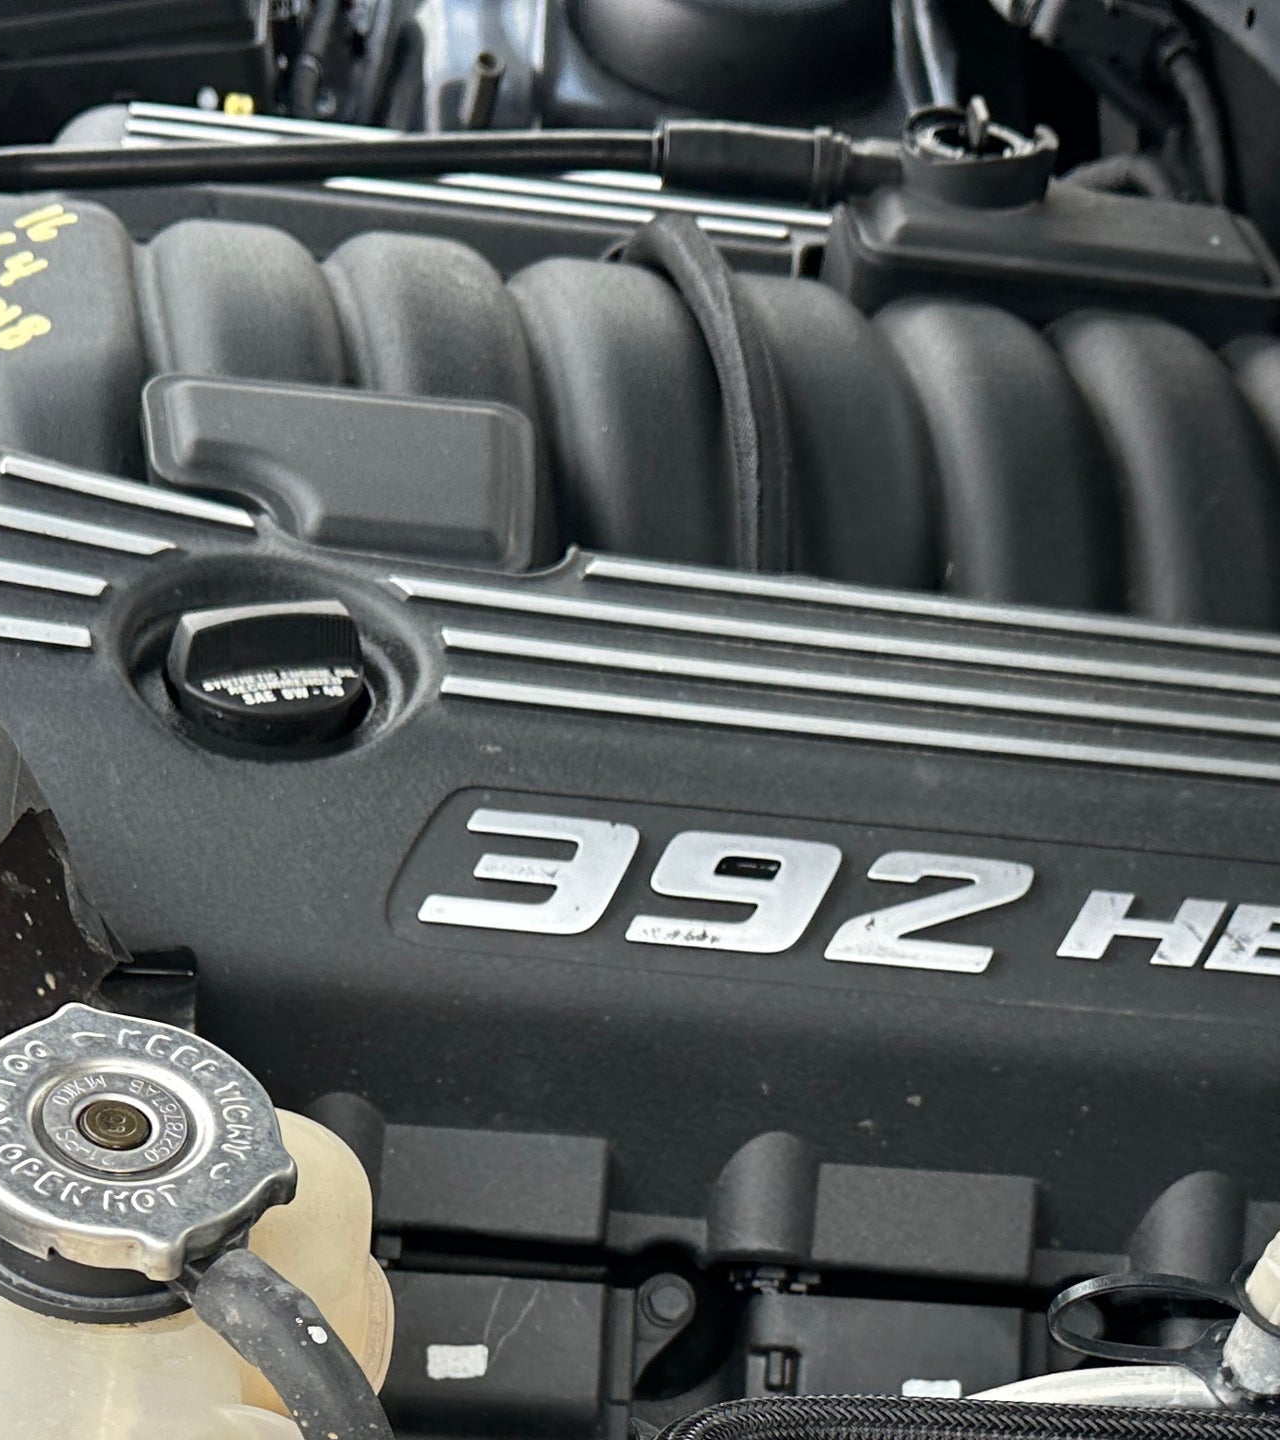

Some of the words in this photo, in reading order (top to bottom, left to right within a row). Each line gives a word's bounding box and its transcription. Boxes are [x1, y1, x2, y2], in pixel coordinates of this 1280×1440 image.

[241, 691, 277, 705] SAE
[418, 807, 1034, 973] 392
[2, 1038, 51, 1075] DO
[102, 1182, 180, 1215] HOT
[51, 1074, 108, 1107] MEXICO
